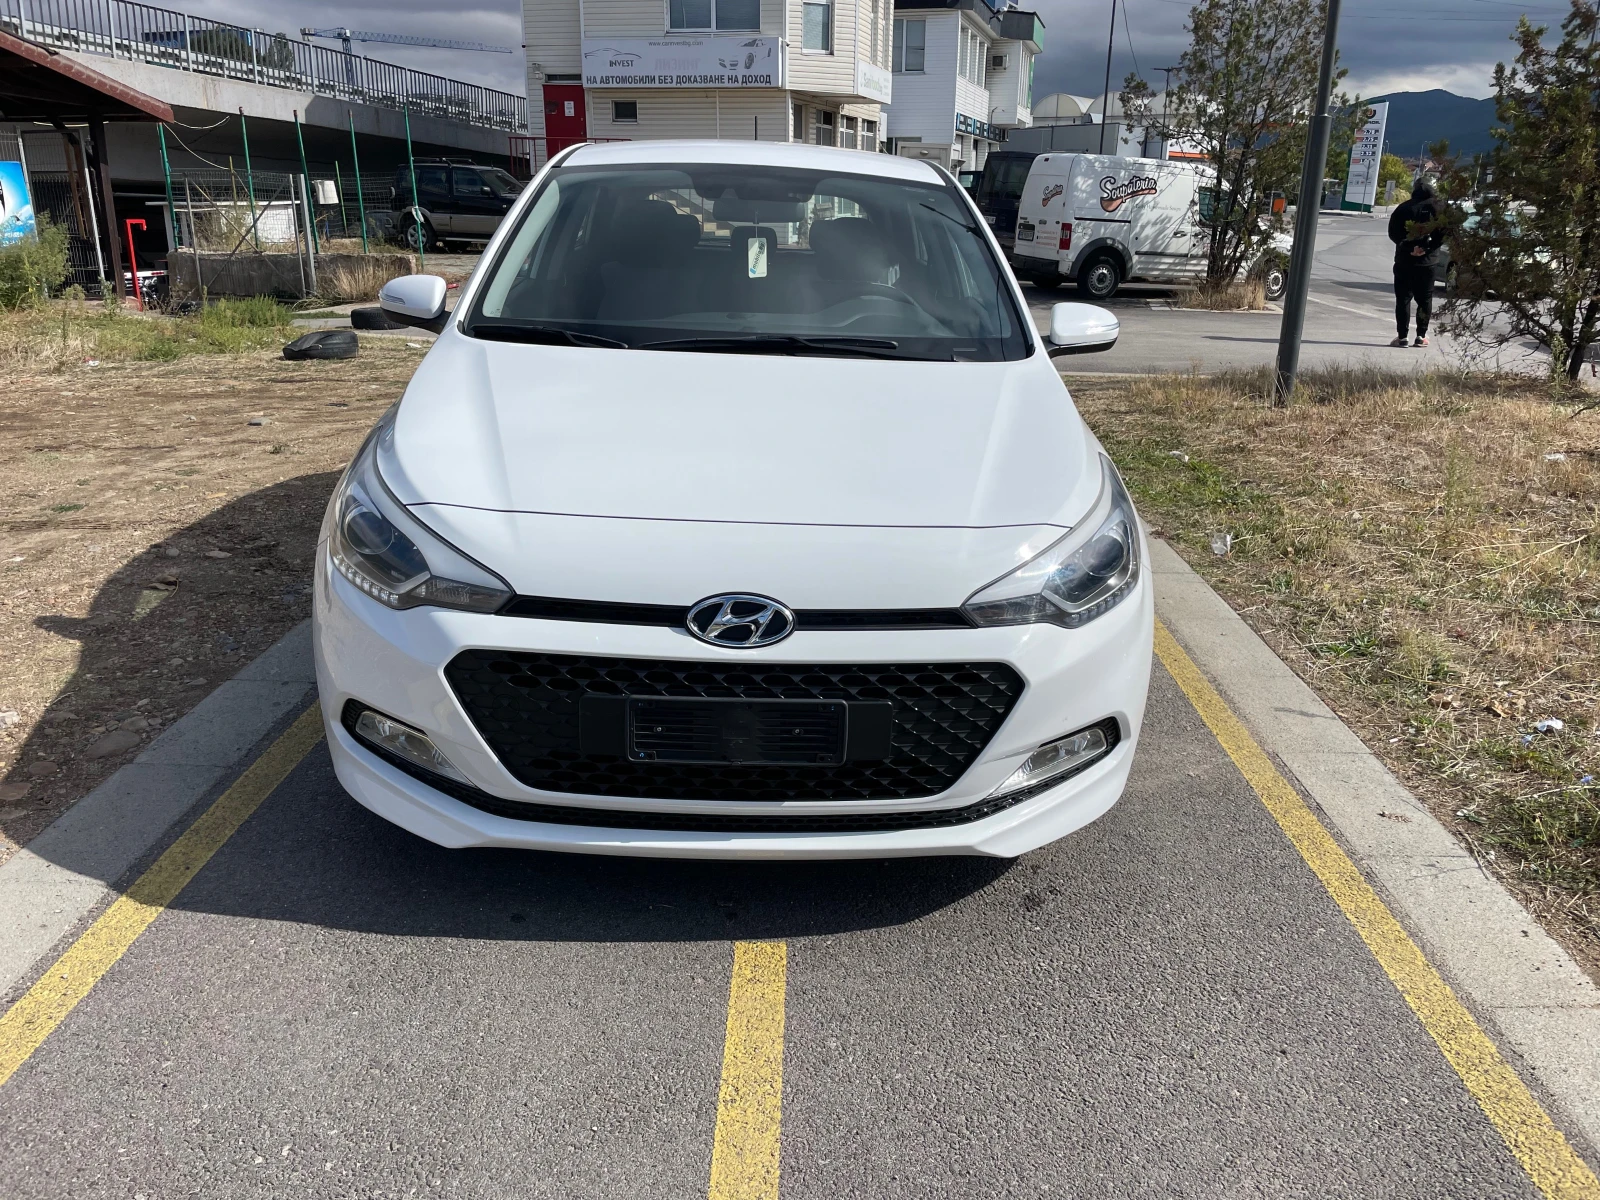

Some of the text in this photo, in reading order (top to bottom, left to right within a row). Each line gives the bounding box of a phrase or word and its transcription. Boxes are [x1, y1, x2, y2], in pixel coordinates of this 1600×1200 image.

[609, 59, 635, 68] INVEST
[586, 75, 772, 86] НА АВТОМОБИЛИ БЕЗ ДОКАЗВАНЕ НА ДОХОД
[1100, 175, 1157, 202] Soupateria
